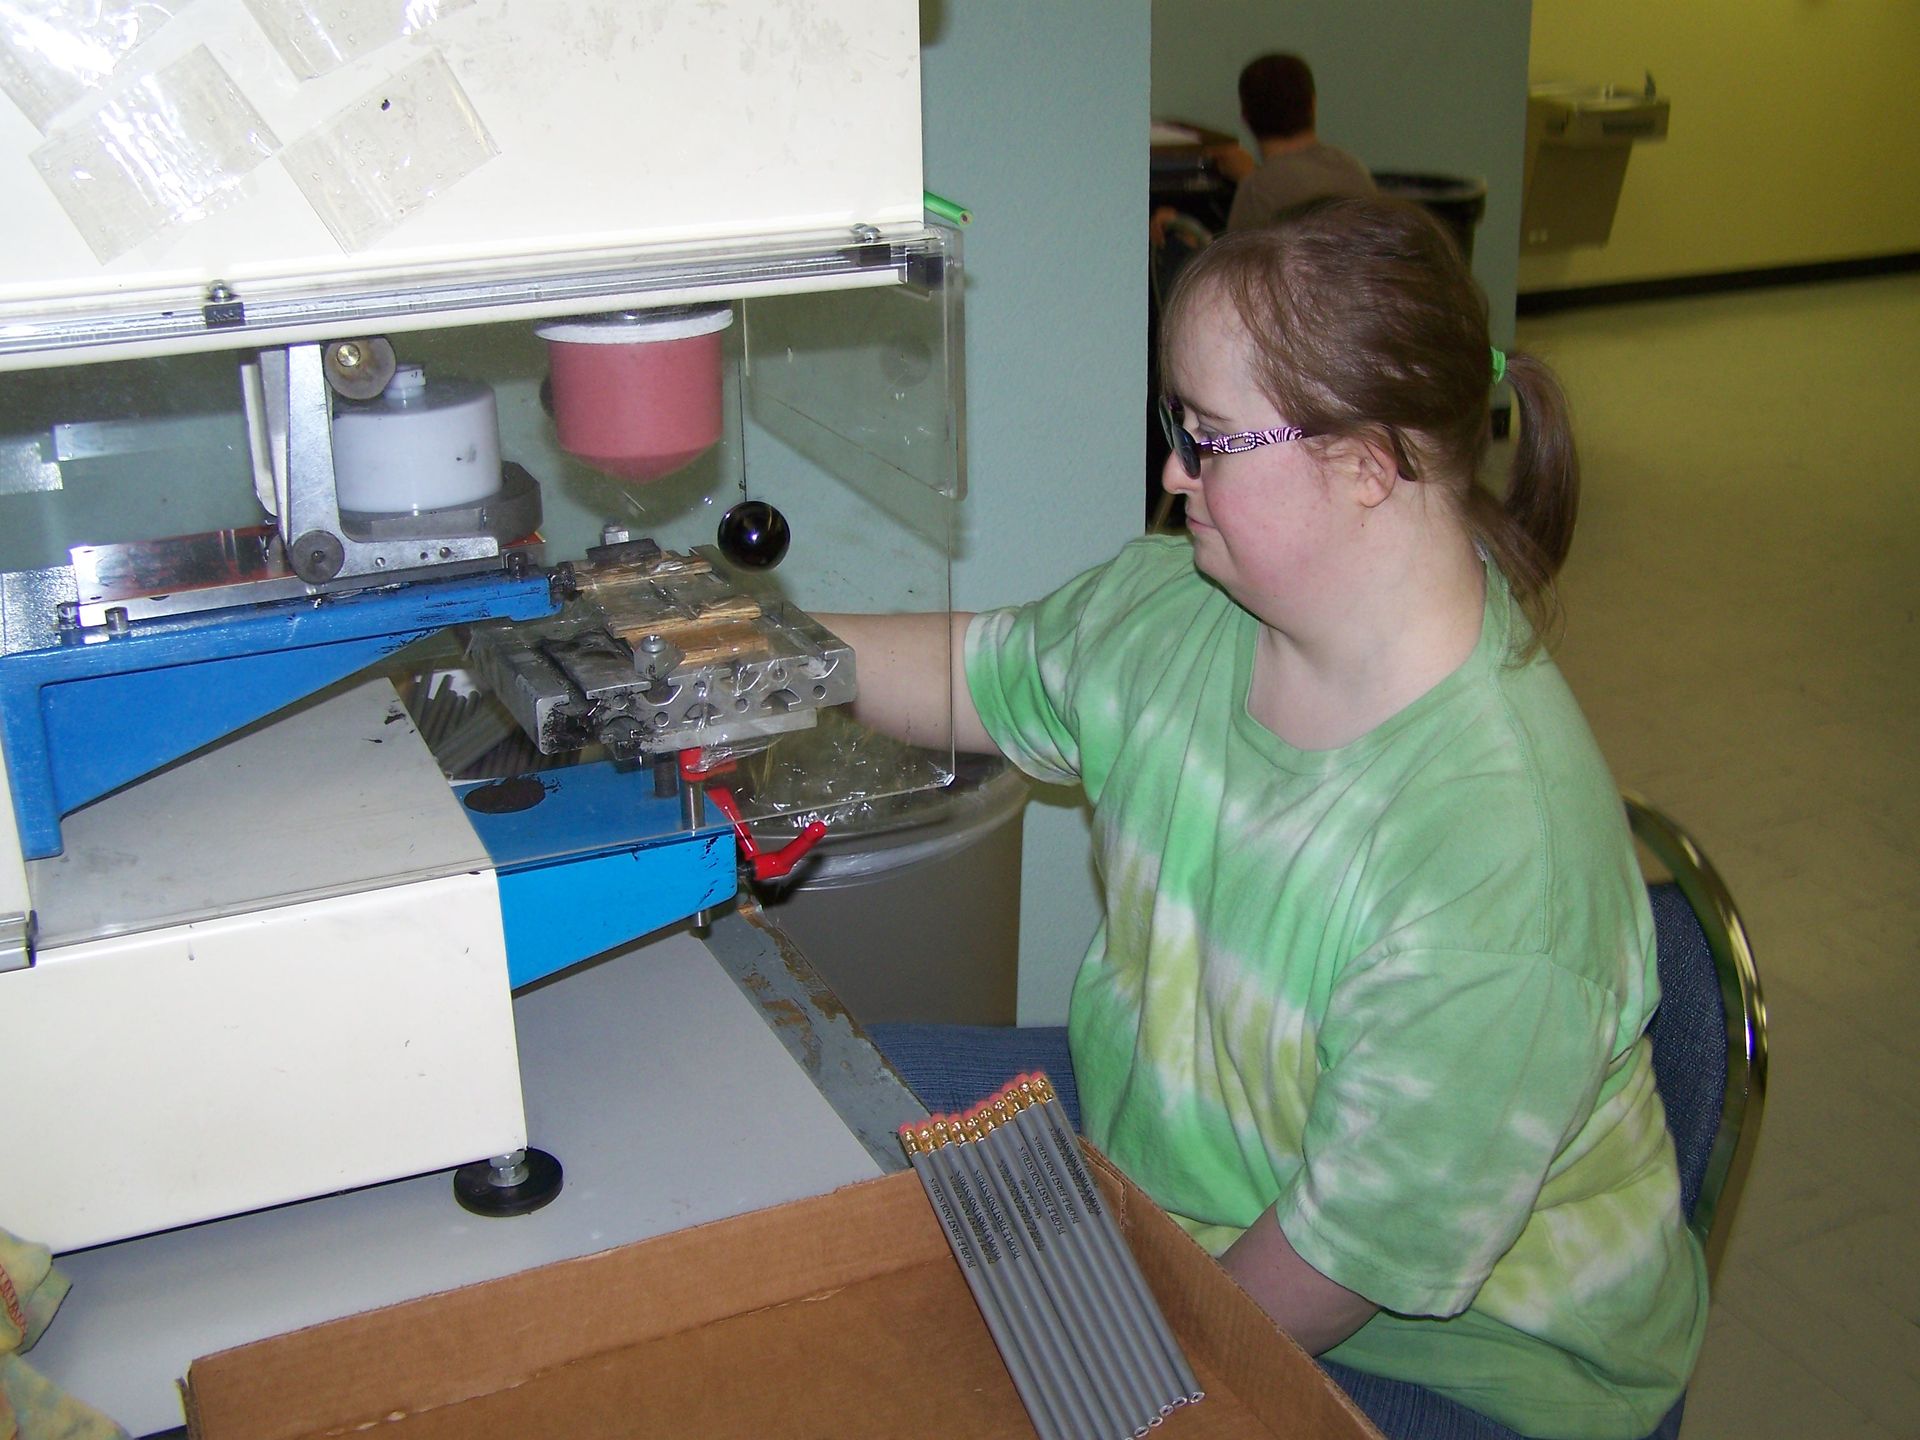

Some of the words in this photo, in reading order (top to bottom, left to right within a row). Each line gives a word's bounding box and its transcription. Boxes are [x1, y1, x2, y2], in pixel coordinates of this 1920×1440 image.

[1016, 1145, 1044, 1187] INDUSTRIES
[1031, 1135, 1057, 1176] INDUSTRIES
[927, 1177, 954, 1220] INDUSTRIES
[953, 1169, 981, 1212] INDUSTRIES
[971, 1168, 999, 1211] INDUSTRIES
[1046, 1206, 1067, 1234] PEOPLE
[1061, 1197, 1081, 1224] PEOPLE
[956, 1240, 976, 1268] PEOPLE
[982, 1232, 1003, 1260] PEOPLE
[1001, 1230, 1022, 1259] PEOPLE
